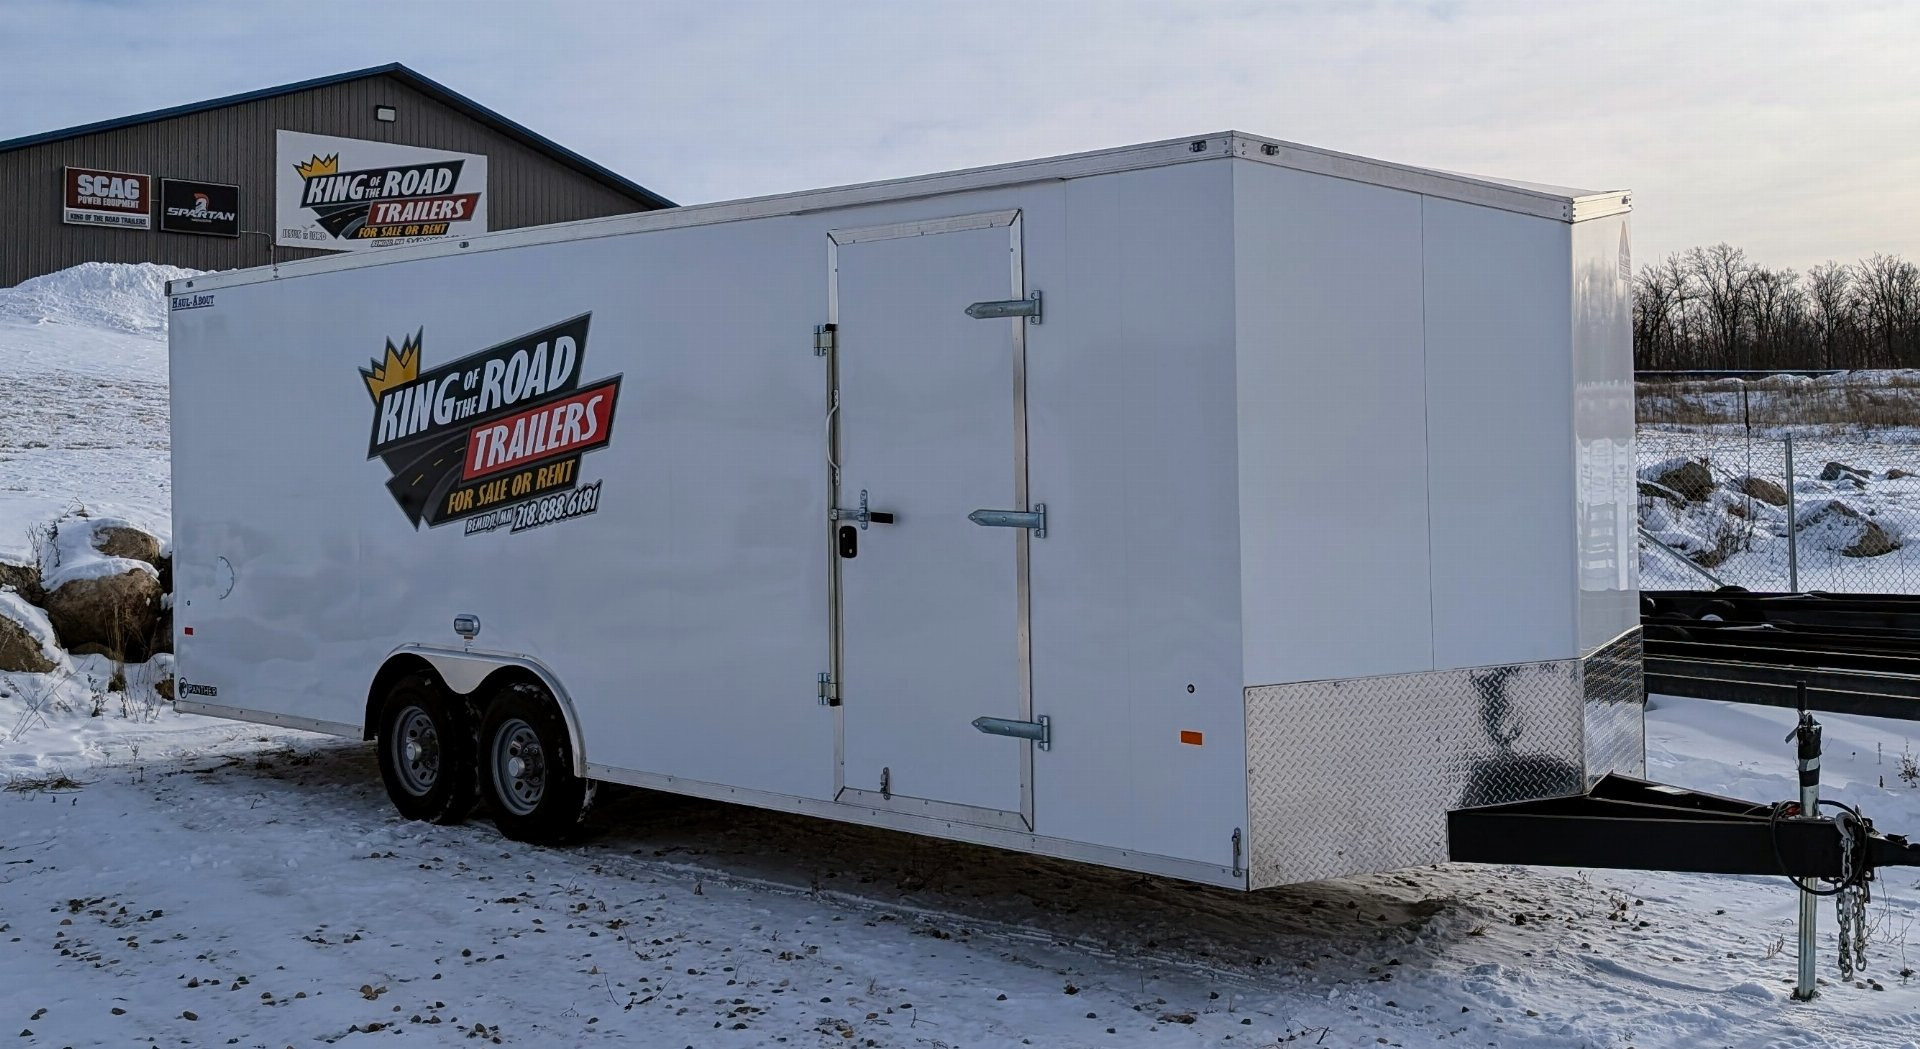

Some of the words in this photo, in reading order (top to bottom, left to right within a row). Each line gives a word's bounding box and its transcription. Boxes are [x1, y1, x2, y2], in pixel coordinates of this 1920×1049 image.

[77, 174, 140, 200] SCAG
[306, 174, 368, 204] KING
[365, 187, 380, 199] THE
[370, 175, 381, 187] OF
[381, 167, 453, 197] ROAD
[77, 195, 102, 206] POWER
[103, 197, 139, 209] EQUIPMENT
[166, 207, 236, 221] SPARTAN
[375, 198, 467, 224] TRAILERS
[70, 213, 84, 221] KING
[94, 214, 103, 222] THE
[105, 215, 120, 223] ROAD
[121, 217, 146, 225] TRAILERS
[358, 226, 377, 239] FOR
[381, 225, 403, 237] SALE
[405, 225, 419, 236] OR
[421, 223, 447, 235] RENT
[463, 367, 481, 391] OF
[478, 335, 577, 413] ROAD
[377, 372, 461, 446] KING
[455, 396, 478, 420] THE
[473, 395, 603, 471] TRAILERS
[447, 488, 474, 515] FOR
[477, 478, 509, 506] SALE
[511, 471, 533, 496] OR
[536, 459, 576, 490] RENT
[500, 508, 514, 525] MN
[514, 486, 600, 531] 218.888.6181
